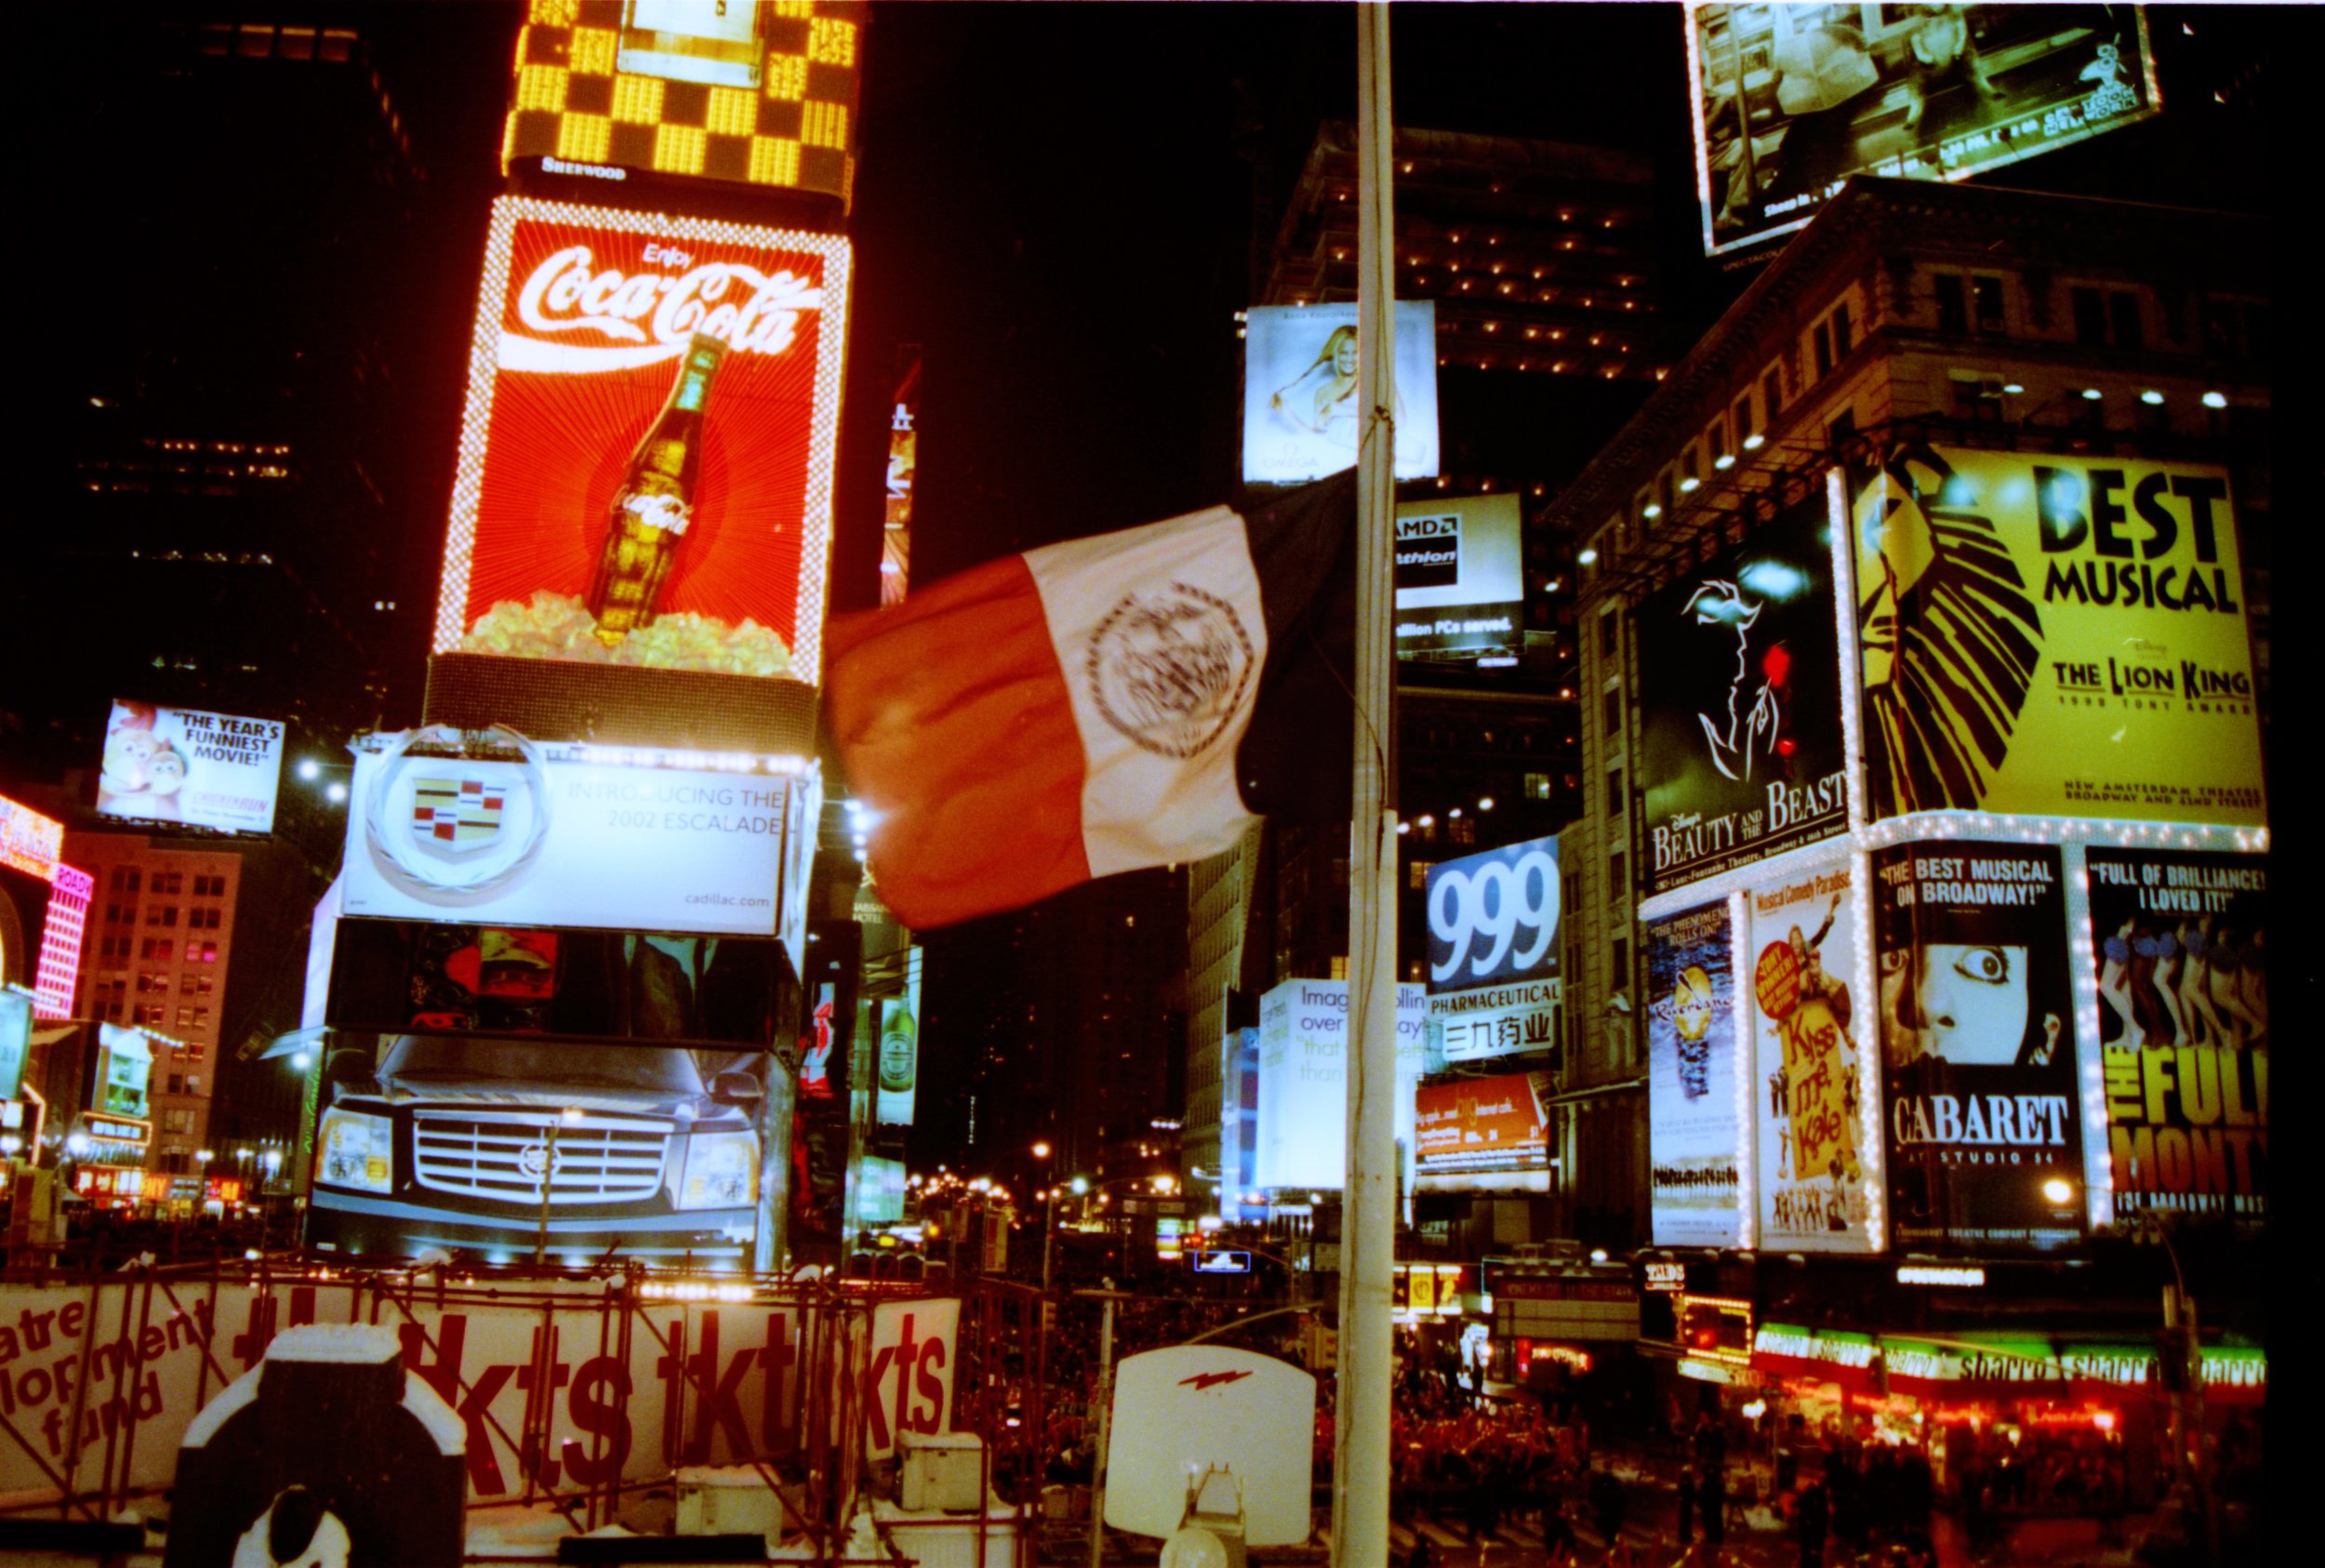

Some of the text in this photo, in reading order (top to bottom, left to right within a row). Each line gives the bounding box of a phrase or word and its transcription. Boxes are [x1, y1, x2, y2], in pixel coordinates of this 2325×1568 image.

[541, 155, 626, 180] SHERWOOD
[643, 244, 697, 269] Enjoy
[517, 245, 822, 355] Coca-Cola
[2033, 465, 2227, 563] BEST
[2043, 558, 2239, 614] MUSICAL
[1435, 619, 1461, 634] PCs
[1463, 616, 1513, 633] served.
[2053, 657, 2251, 699] THE LION KING
[2058, 696, 2106, 708] 1998
[2121, 698, 2171, 711] TONY
[185, 728, 271, 753] FUNNIEST
[219, 716, 279, 739] YEAR'S
[741, 789, 783, 809] THE
[2065, 780, 2095, 791] NEW
[2103, 782, 2191, 796] AMSTERDAM
[2065, 791, 2137, 804] BROADWAY
[2145, 794, 2172, 804] AND
[238, 796, 269, 814] RUN
[607, 808, 782, 835] 2002 ESCALADE
[1652, 772, 1849, 871] BEAUTY AND THE BEAST
[1765, 841, 1796, 857] Broadway
[1823, 821, 1846, 837] Street
[1915, 857, 1964, 880] BEST
[1970, 858, 2053, 883] MUSICAL
[2089, 862, 2266, 891] “FULL OF BRILLIANCE!
[685, 892, 770, 909] cadillac.com
[1896, 882, 2047, 908] ON BROADWAY!”
[2139, 886, 2146, 910] I
[2149, 887, 2199, 912] LOVED
[1428, 850, 1561, 982] 999
[1430, 985, 1561, 1016] PHARMACEUTICAL
[1301, 1017, 1344, 1031] over
[1446, 1012, 1550, 1055] 三九药业
[1788, 1011, 1838, 1066] Kiss
[2104, 1045, 2142, 1125] THE
[1893, 1093, 2069, 1147] CABARET
[1797, 1098, 1841, 1172] Kate
[1908, 1151, 2053, 1165] AT STUDIO 54
[2149, 1192, 2225, 1213] BROADWAY
[1987, 1228, 2027, 1240] COMPANY
[1960, 1349, 2047, 1382] sbarro
[41, 1371, 163, 1456] fund
